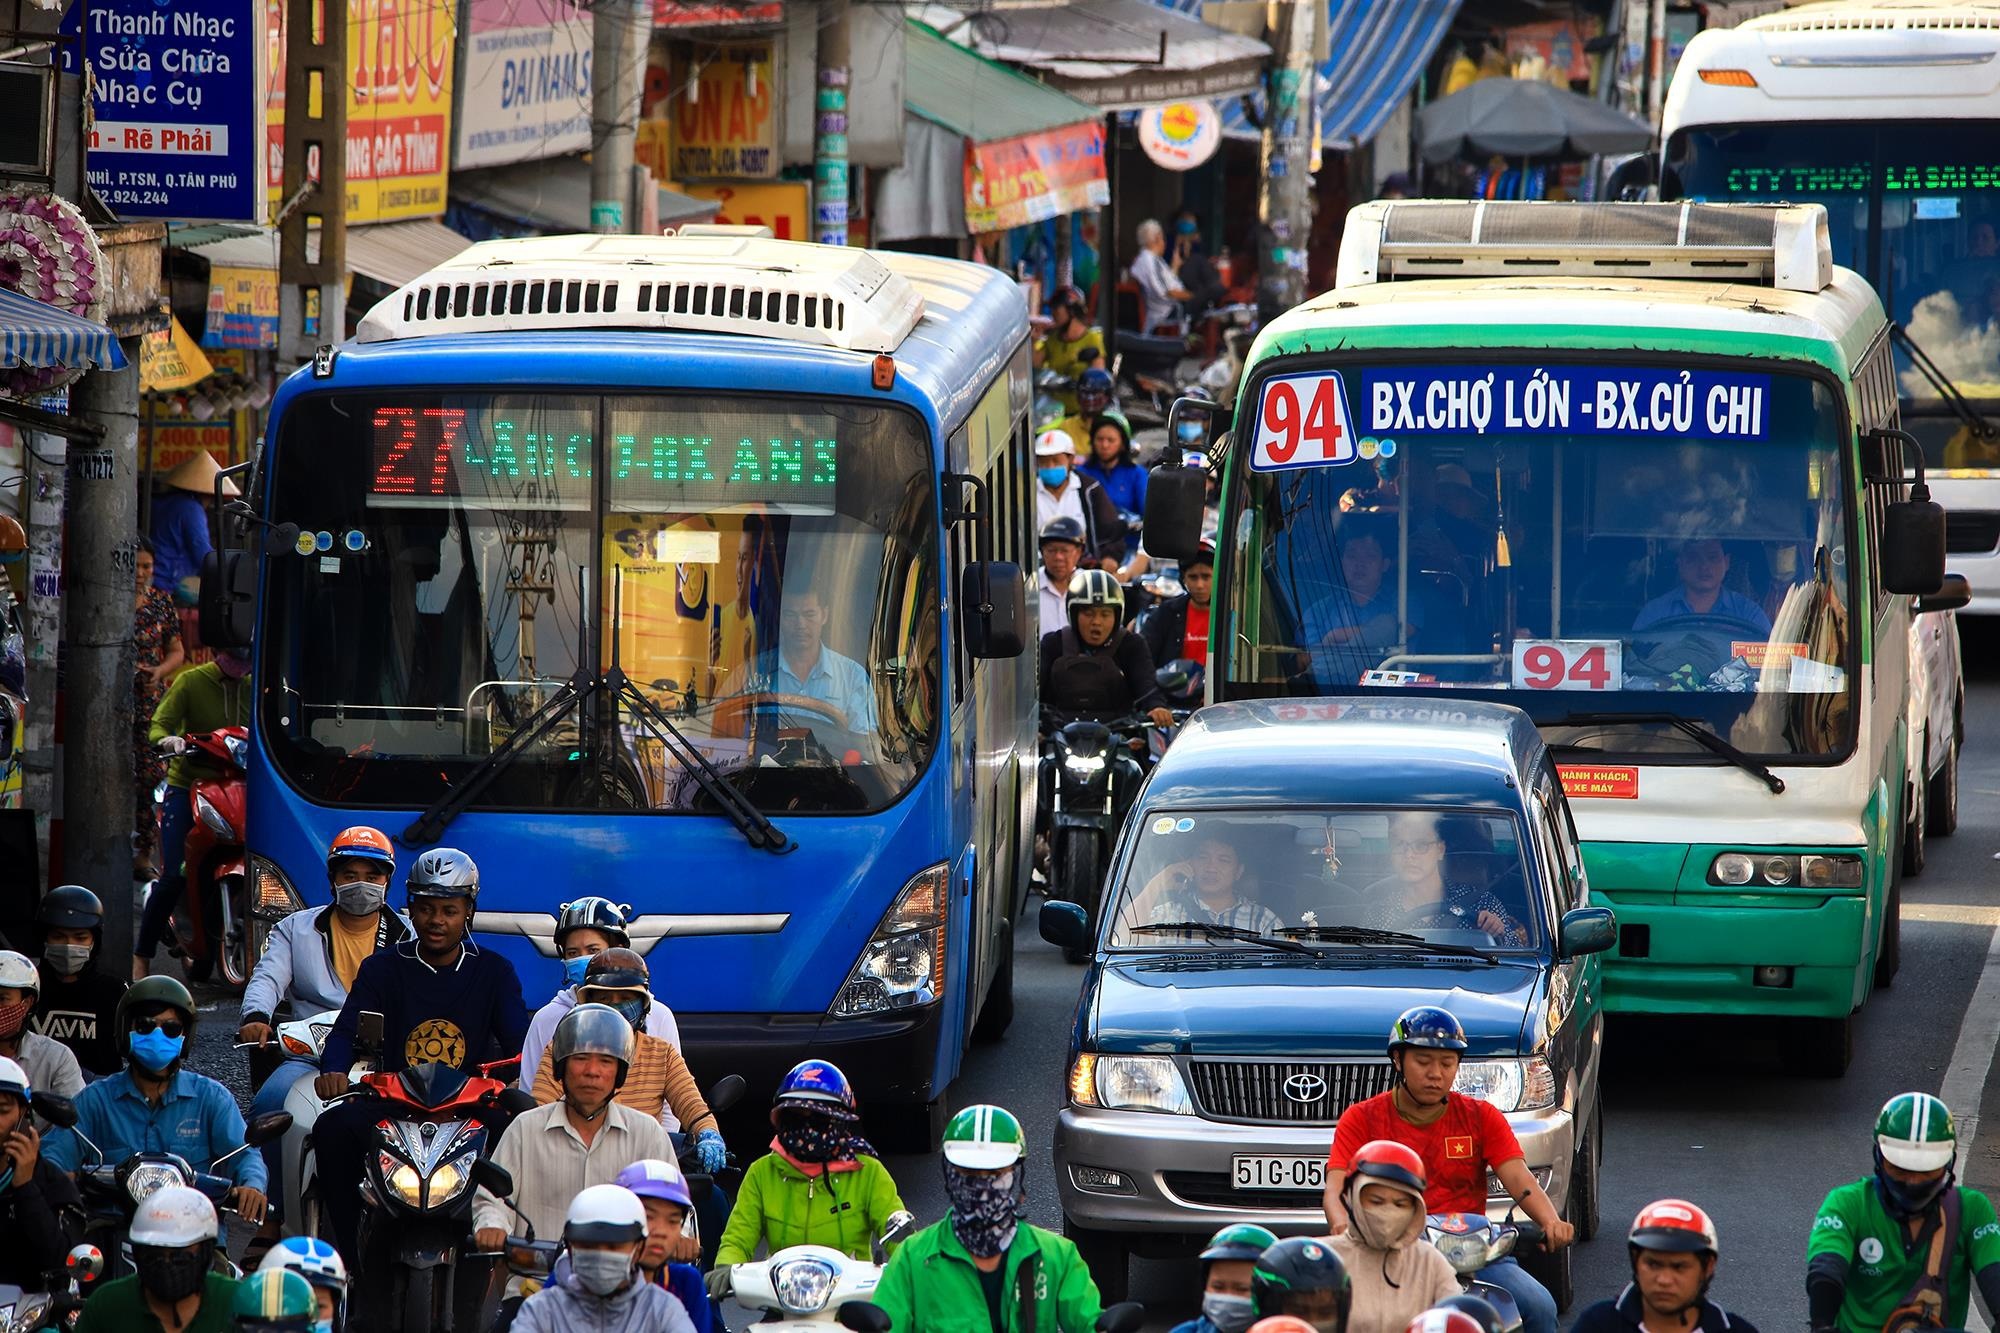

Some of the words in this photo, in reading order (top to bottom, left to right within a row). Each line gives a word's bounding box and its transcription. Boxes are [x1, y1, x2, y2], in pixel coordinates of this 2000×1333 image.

[90, 9, 165, 35] Thanh
[173, 12, 235, 42] Nhạc
[99, 45, 151, 70] Sửa
[162, 49, 231, 73] Chữa
[92, 79, 157, 108] Nhạc
[167, 81, 202, 110] Cụ
[124, 128, 153, 150] Rẽ
[161, 128, 212, 151] Phải
[375, 124, 403, 176] CÁC
[119, 171, 161, 188] P.TSN,
[165, 172, 205, 189] Q.TÂN
[1372, 373, 1497, 434] BX.CHỢ
[1505, 368, 1571, 430] LỚN
[1706, 384, 1763, 436] CHI
[1263, 377, 1344, 464] 94
[372, 407, 466, 493] 27
[1522, 645, 1611, 689] 94
[1561, 770, 1590, 780] HÀNH
[1574, 783, 1587, 792] XE
[1590, 782, 1614, 792] MÁY
[1237, 1159, 1329, 1186] 51G-05
